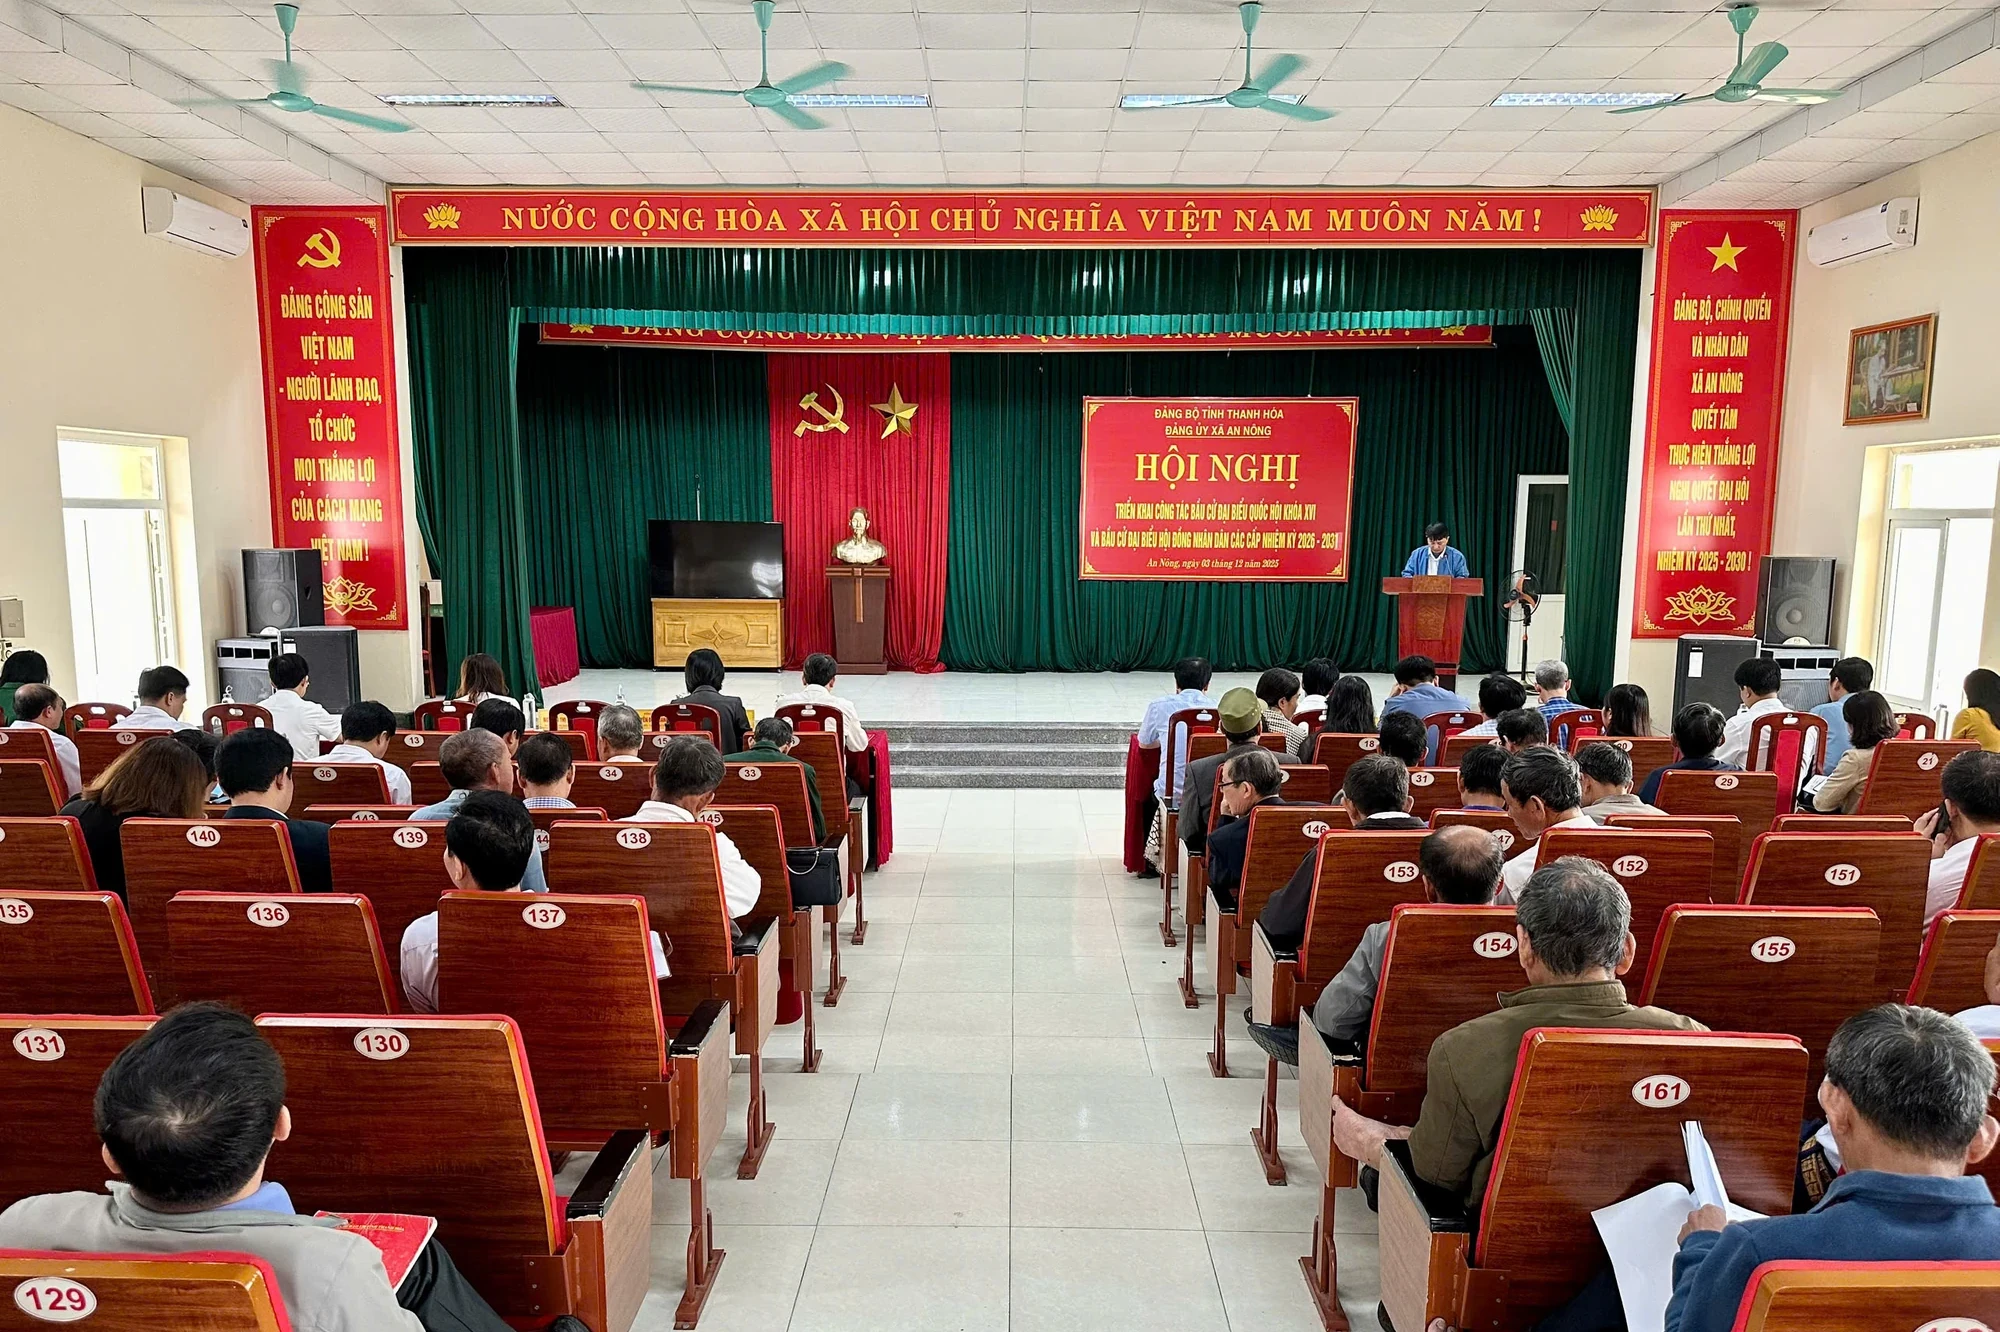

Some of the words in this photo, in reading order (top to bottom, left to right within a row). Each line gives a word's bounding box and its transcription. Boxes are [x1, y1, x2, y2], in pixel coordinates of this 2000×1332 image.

[501, 198, 597, 230] NƯỚC
[610, 200, 705, 236] CỘNG
[715, 200, 787, 231] HÒA
[798, 202, 848, 231] XÃ
[860, 201, 920, 238] HỘI
[930, 198, 1002, 231] CHỦ
[1013, 202, 1127, 231] NGHĨA
[1138, 201, 1222, 239] VIỆT
[1233, 209, 1313, 232] NAM
[1326, 200, 1432, 232] MUÔN
[1445, 201, 1526, 232] NĂM
[280, 286, 313, 318] ĐẢNG
[315, 289, 346, 324] CỘNG
[349, 286, 373, 319] SẢN
[1673, 292, 1698, 321] ĐẢNG
[1699, 295, 1713, 326] BỘ,
[1715, 294, 1742, 321] CHÍNH
[300, 331, 324, 365] VIỆT
[327, 336, 355, 360] NAM
[1691, 331, 1703, 357] VÀ
[1704, 331, 1729, 357] NHÂN
[1730, 331, 1749, 357] DÂN
[1691, 368, 1703, 393] XÃ
[1704, 372, 1718, 393] AN
[1718, 368, 1744, 393] NÔNG
[286, 371, 321, 401] NGƯỜI
[323, 372, 353, 401] LÃNH
[355, 377, 382, 407] ĐẠO,
[1154, 406, 1182, 419] ĐẢNG
[1185, 407, 1199, 421] BỘ
[1202, 406, 1224, 419] TỈNH
[1227, 409, 1260, 419] THANH
[1263, 407, 1284, 419] HÓA
[1691, 401, 1719, 432] QUYẾT
[1719, 404, 1738, 429] TÂM
[308, 408, 323, 442] TỔ
[326, 413, 355, 442] CHỨC
[1165, 422, 1193, 436] ĐẢNG
[1195, 422, 1209, 436] ỦY
[1211, 424, 1225, 436] XÃ
[1226, 426, 1240, 436] AN
[1243, 424, 1272, 436] NÔNG
[1669, 442, 1691, 470] THỰC
[1691, 440, 1712, 470] HIỆN
[1713, 436, 1741, 466] THẮNG
[1742, 442, 1756, 470] LỢI
[294, 458, 316, 486] MỌI
[318, 450, 355, 482] THẮNG
[358, 456, 376, 487] LỢI
[1135, 445, 1200, 490] HỘI
[1208, 454, 1300, 490] NGHỊ
[1719, 480, 1734, 506] ĐẠI
[1734, 476, 1750, 506] HỘI
[291, 490, 314, 522] CỦA
[317, 493, 347, 522] CÁCH
[350, 499, 383, 527] MẠNG
[1115, 496, 1135, 520] TRIỂN
[1136, 503, 1154, 519] KHAI
[1155, 500, 1174, 520] CÔNG
[1176, 500, 1189, 520] TÁC
[1218, 504, 1230, 524] ĐẠI
[1231, 497, 1248, 520] BIỂU
[1249, 498, 1269, 522] QUỐC
[1269, 501, 1282, 524] HỘI
[1283, 500, 1302, 520] KHÓA
[1303, 504, 1317, 520] XVI
[1696, 511, 1713, 536] THỨ
[1128, 531, 1140, 552] ĐẠI
[1159, 528, 1171, 552] HỘI
[1193, 528, 1213, 548] NHÂN
[1214, 529, 1229, 548] DÂN
[1230, 529, 1245, 549] CÁC
[1262, 529, 1286, 552] NHIỆM
[1297, 532, 1315, 549] 2026
[338, 538, 363, 561] NAM
[1147, 558, 1158, 567] An
[1657, 546, 1684, 575] NHIỆM
[1685, 546, 1697, 571] KỲ
[1698, 551, 1719, 571] 2025
[1725, 551, 1746, 572] 2030
[121, 734, 132, 742] 12
[409, 737, 420, 745] 13
[1364, 740, 1375, 748] 18
[1922, 757, 1933, 765] 21
[319, 769, 332, 778] 36
[605, 769, 617, 777] 34
[744, 769, 756, 778] 33
[1416, 774, 1428, 783] 31
[1720, 777, 1733, 786] 29
[700, 813, 721, 823] 145
[191, 830, 216, 842] 140
[398, 831, 424, 844] 139
[1306, 825, 1327, 836] 146
[621, 833, 647, 844] 138
[1389, 866, 1415, 878] 153
[1618, 860, 1644, 872] 152
[1831, 869, 1855, 881] 151
[252, 907, 285, 921] 136
[528, 909, 560, 923] 137
[1480, 938, 1512, 952] 154
[1758, 942, 1790, 956] 155
[20, 1035, 60, 1053] 131
[361, 1035, 402, 1053] 130
[1641, 1083, 1681, 1100] 161
[26, 1287, 86, 1311] 129
